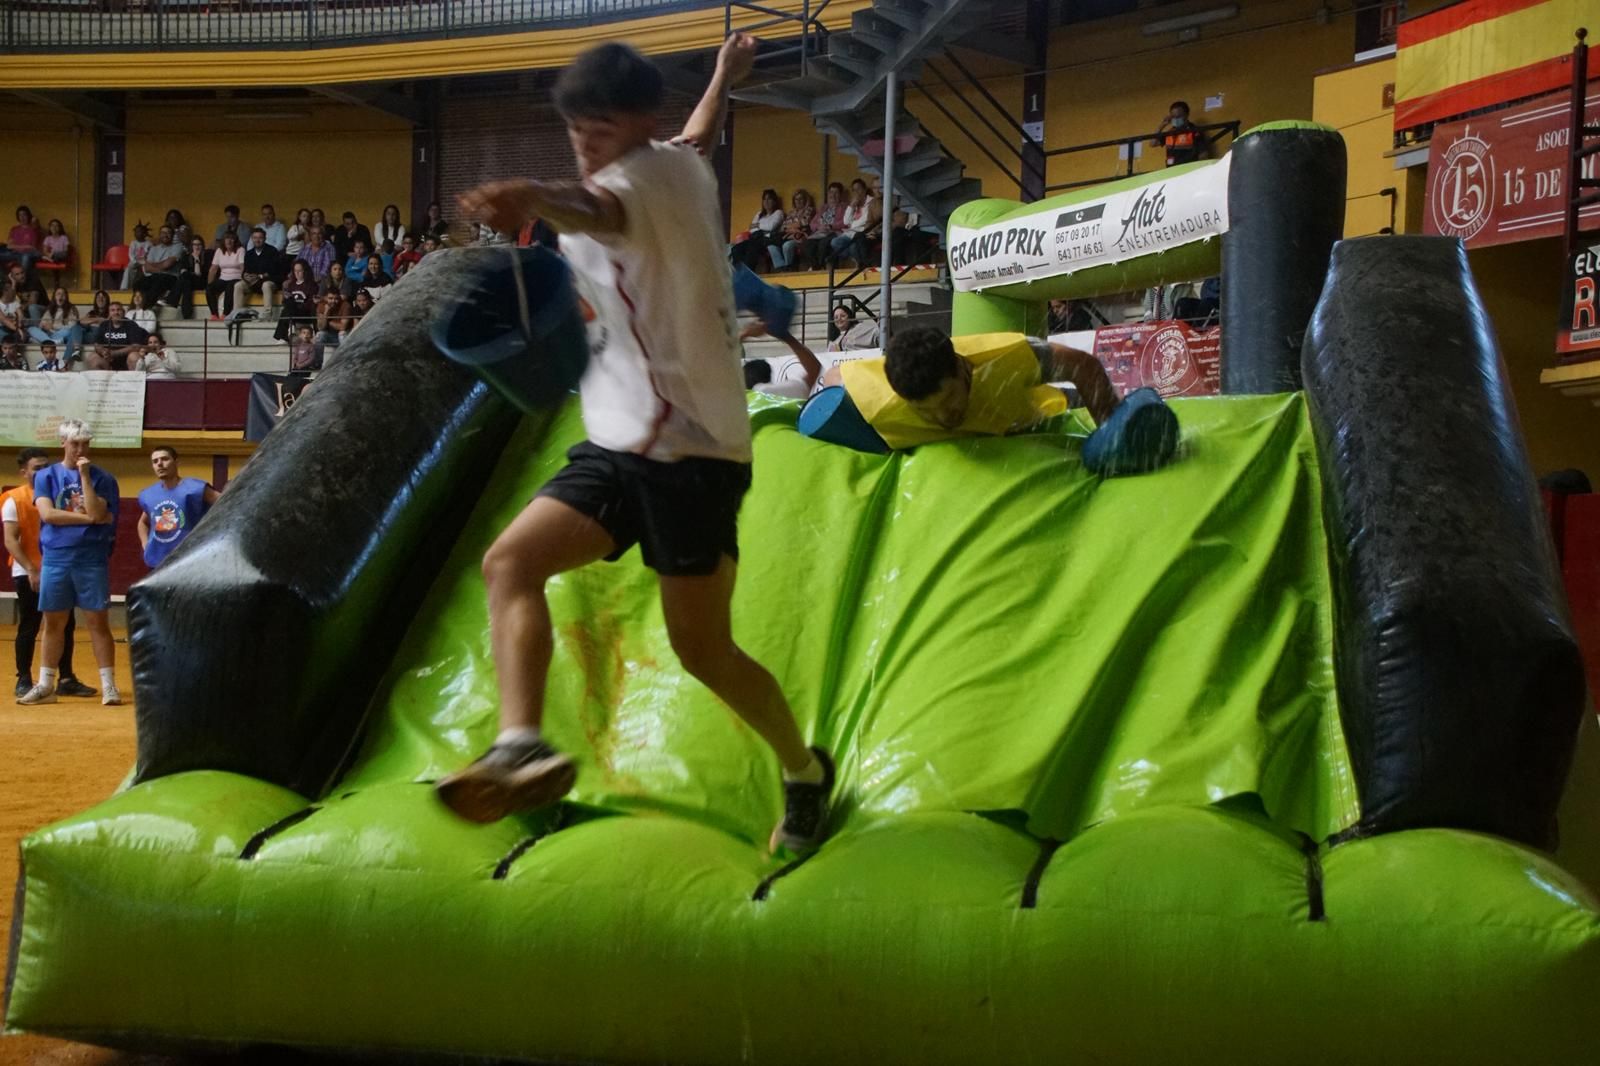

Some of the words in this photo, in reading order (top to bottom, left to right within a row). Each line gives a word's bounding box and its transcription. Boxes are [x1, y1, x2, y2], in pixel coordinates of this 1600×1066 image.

[1503, 166, 1525, 206] 15
[1535, 168, 1561, 200] DE
[1081, 225, 1090, 239] 20
[1091, 223, 1101, 237] 17
[950, 230, 1003, 272] GRAND
[1004, 227, 1047, 257] PRIX
[1057, 248, 1072, 261] 643
[1072, 246, 1081, 258] 77
[1083, 243, 1093, 255] 46
[1093, 241, 1104, 253] 63
[973, 270, 997, 281] Humor
[997, 261, 1024, 278] Amarillo
